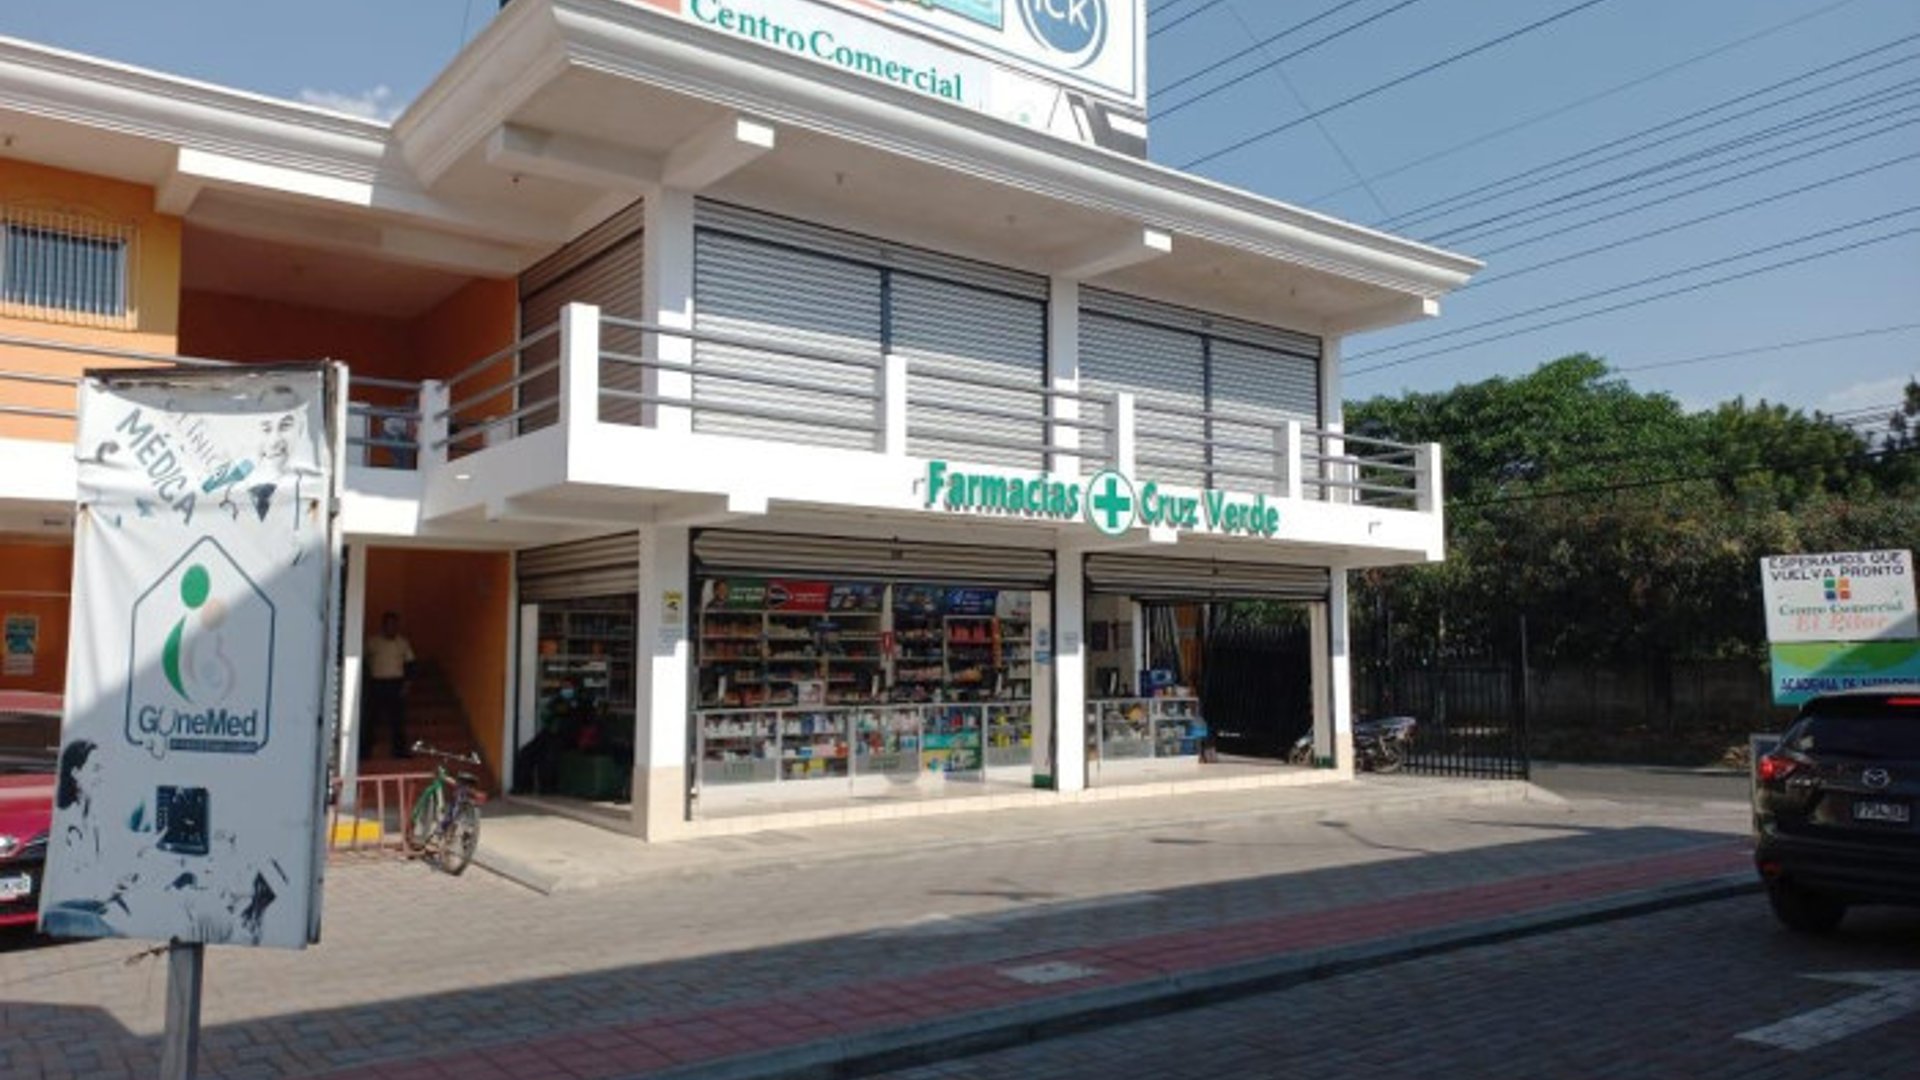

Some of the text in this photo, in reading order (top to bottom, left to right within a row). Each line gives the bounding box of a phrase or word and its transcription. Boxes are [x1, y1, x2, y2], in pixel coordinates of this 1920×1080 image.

[690, 0, 963, 101] Centro Comercial
[115, 408, 197, 526] MÉDICA
[926, 461, 1280, 535] Farmacias Cruz Verde
[1768, 552, 1903, 569] ESPERAMOS QUE
[1770, 565, 1905, 581] VUELVA PRONTO
